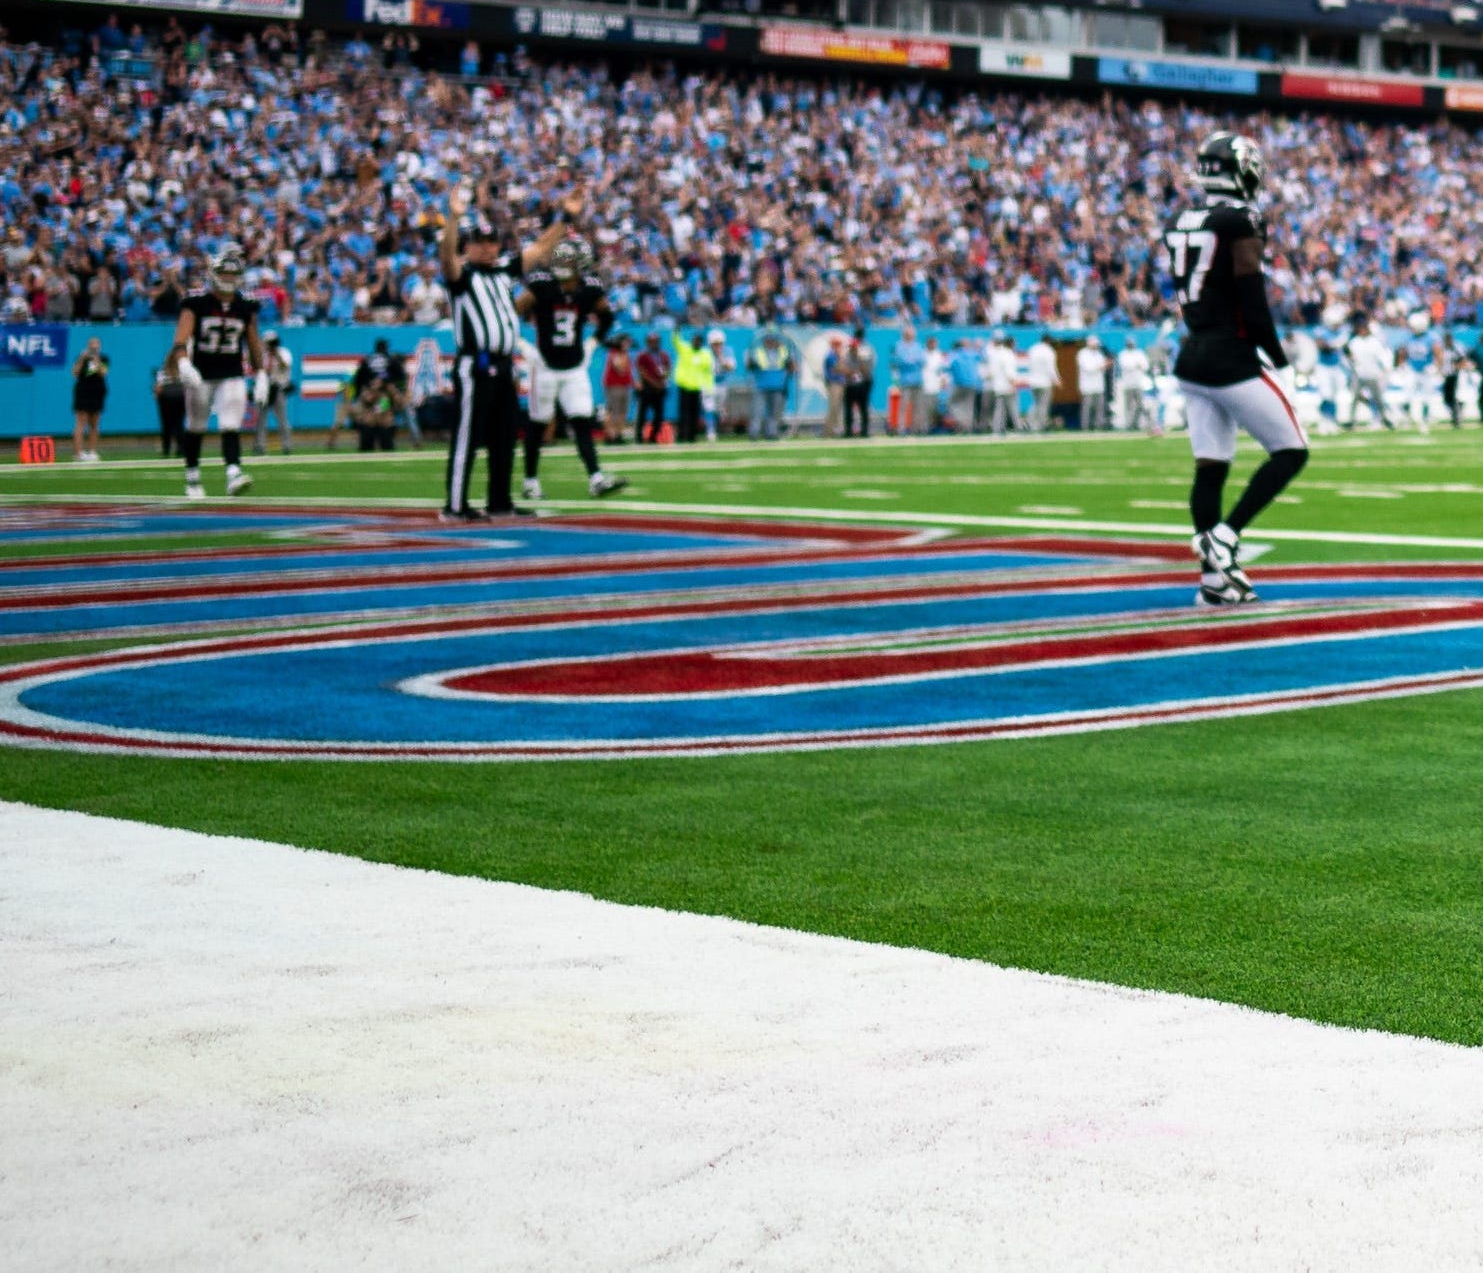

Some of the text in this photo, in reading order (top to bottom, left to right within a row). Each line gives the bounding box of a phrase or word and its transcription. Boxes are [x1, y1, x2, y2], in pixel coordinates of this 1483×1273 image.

[199, 315, 245, 354] 53
[552, 309, 577, 347] 3
[7, 334, 57, 357] NFL
[28, 438, 51, 463] 10
